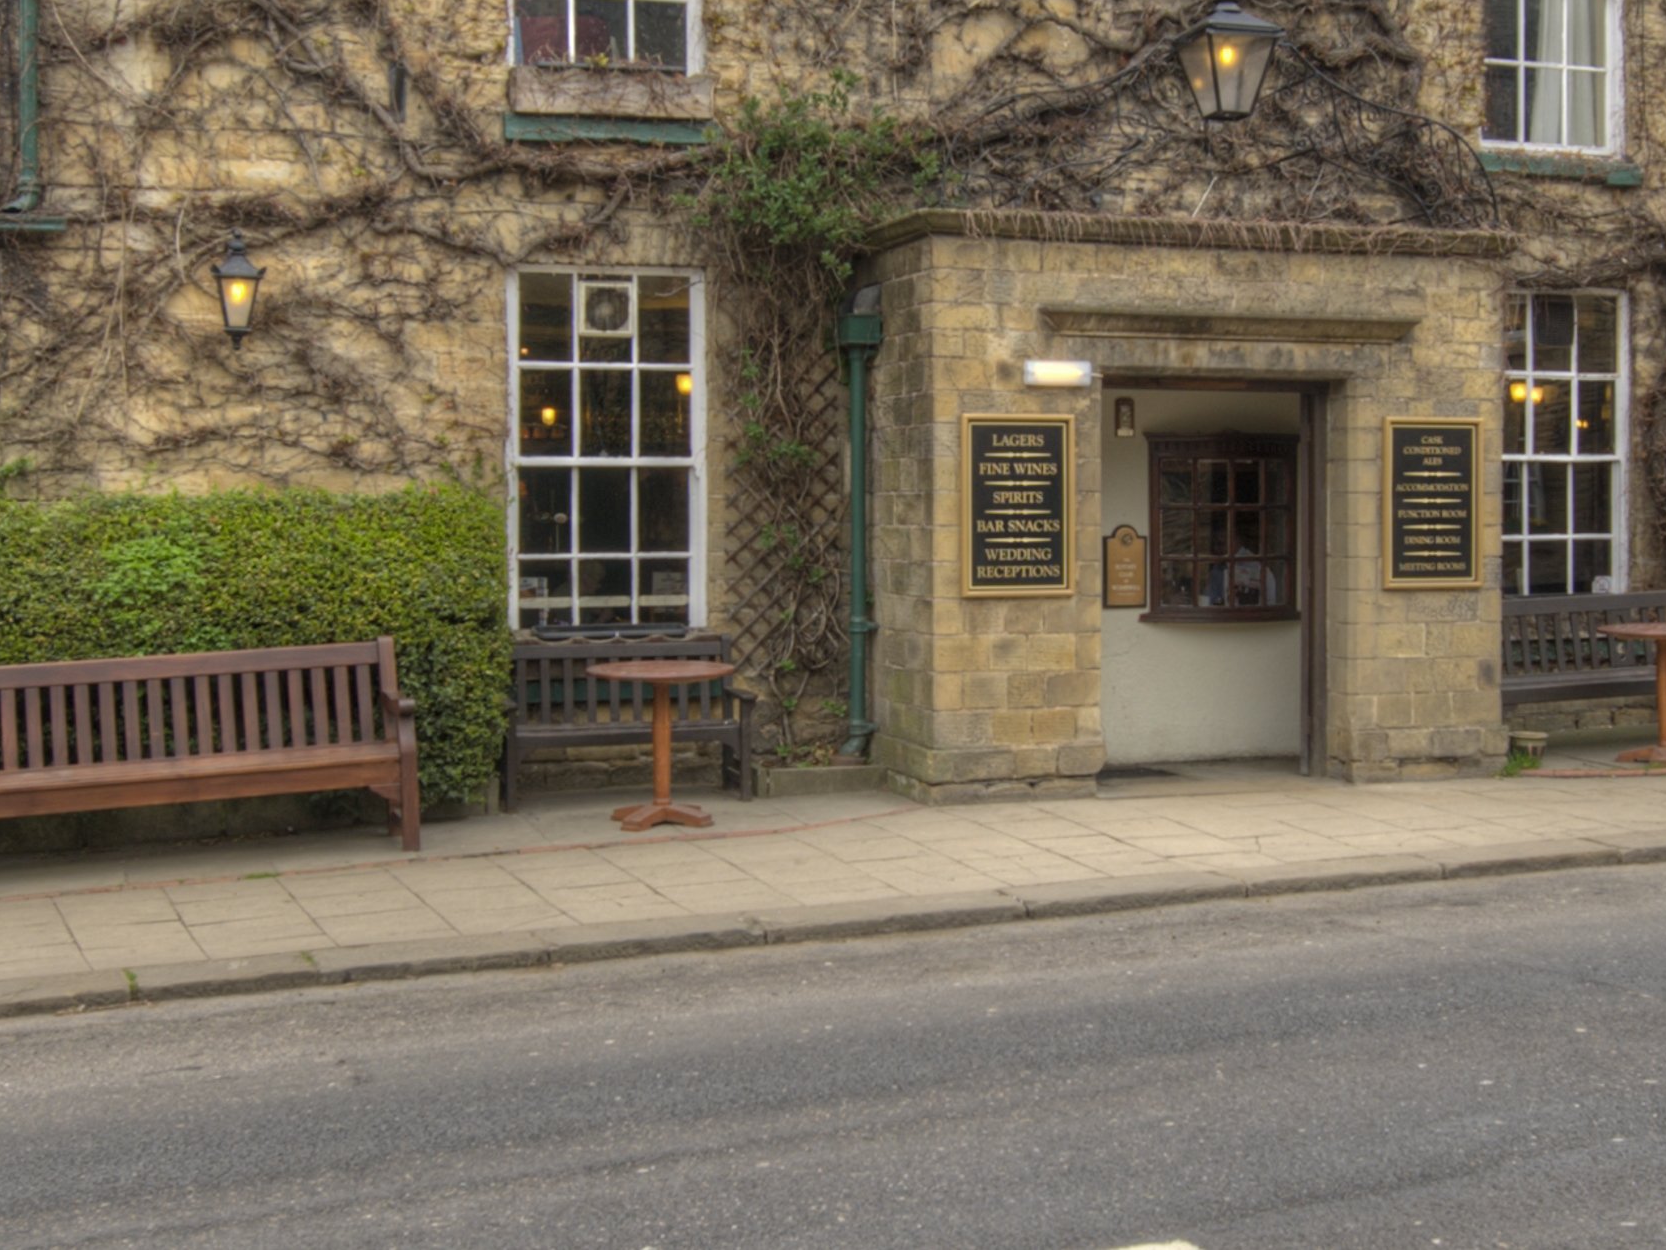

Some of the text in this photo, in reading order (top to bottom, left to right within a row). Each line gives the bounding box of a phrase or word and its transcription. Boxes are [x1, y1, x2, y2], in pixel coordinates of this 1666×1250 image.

[992, 434, 1044, 447] LAGERS
[1421, 435, 1444, 445] CASK
[1403, 446, 1462, 455] CONDITIONED
[979, 463, 1058, 476] FINE WINES
[1395, 483, 1469, 492] ACCOMMODATION
[992, 491, 1044, 504] SPIRITS
[1397, 509, 1467, 518] FUNCTION ROOM
[976, 519, 1061, 532] BAR SNACKS
[1435, 535, 1461, 545] ROOM
[985, 548, 1052, 561] WEDDING
[977, 565, 1061, 578] RECEPTIONS
